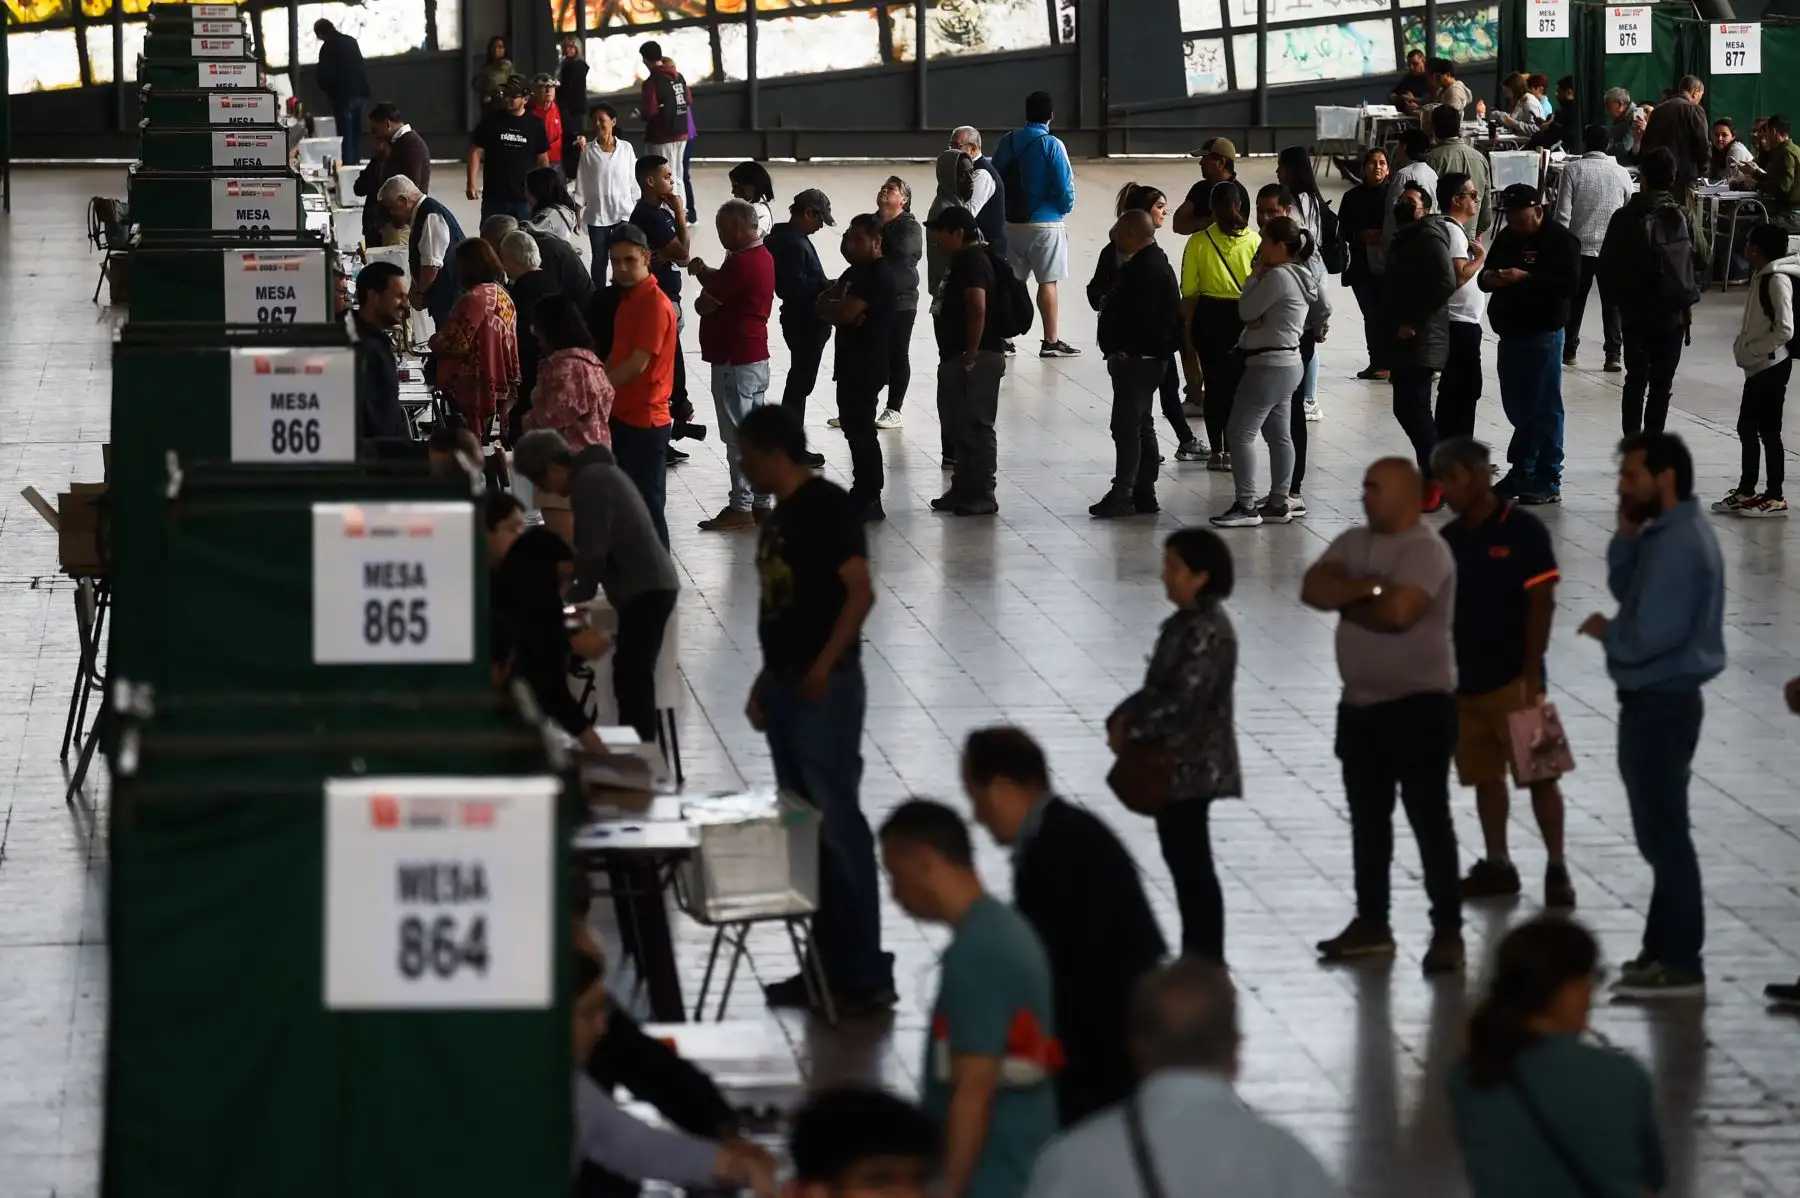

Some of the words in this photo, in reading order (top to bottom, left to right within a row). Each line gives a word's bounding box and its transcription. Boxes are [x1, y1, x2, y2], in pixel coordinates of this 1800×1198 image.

[1539, 9, 1556, 17] MESA
[1538, 18, 1556, 33] 875
[1618, 23, 1638, 31] MESA
[1619, 32, 1637, 47] 876
[1725, 41, 1745, 49] MESA
[1725, 50, 1746, 67] 877
[232, 157, 263, 167] MESA
[236, 208, 271, 221] MESA
[255, 285, 296, 301] MESA
[270, 392, 320, 411] MESA
[271, 418, 321, 455] 866
[363, 561, 427, 590] MESA
[363, 598, 429, 647] 865
[396, 860, 490, 907] MESA
[397, 914, 490, 982] 864
